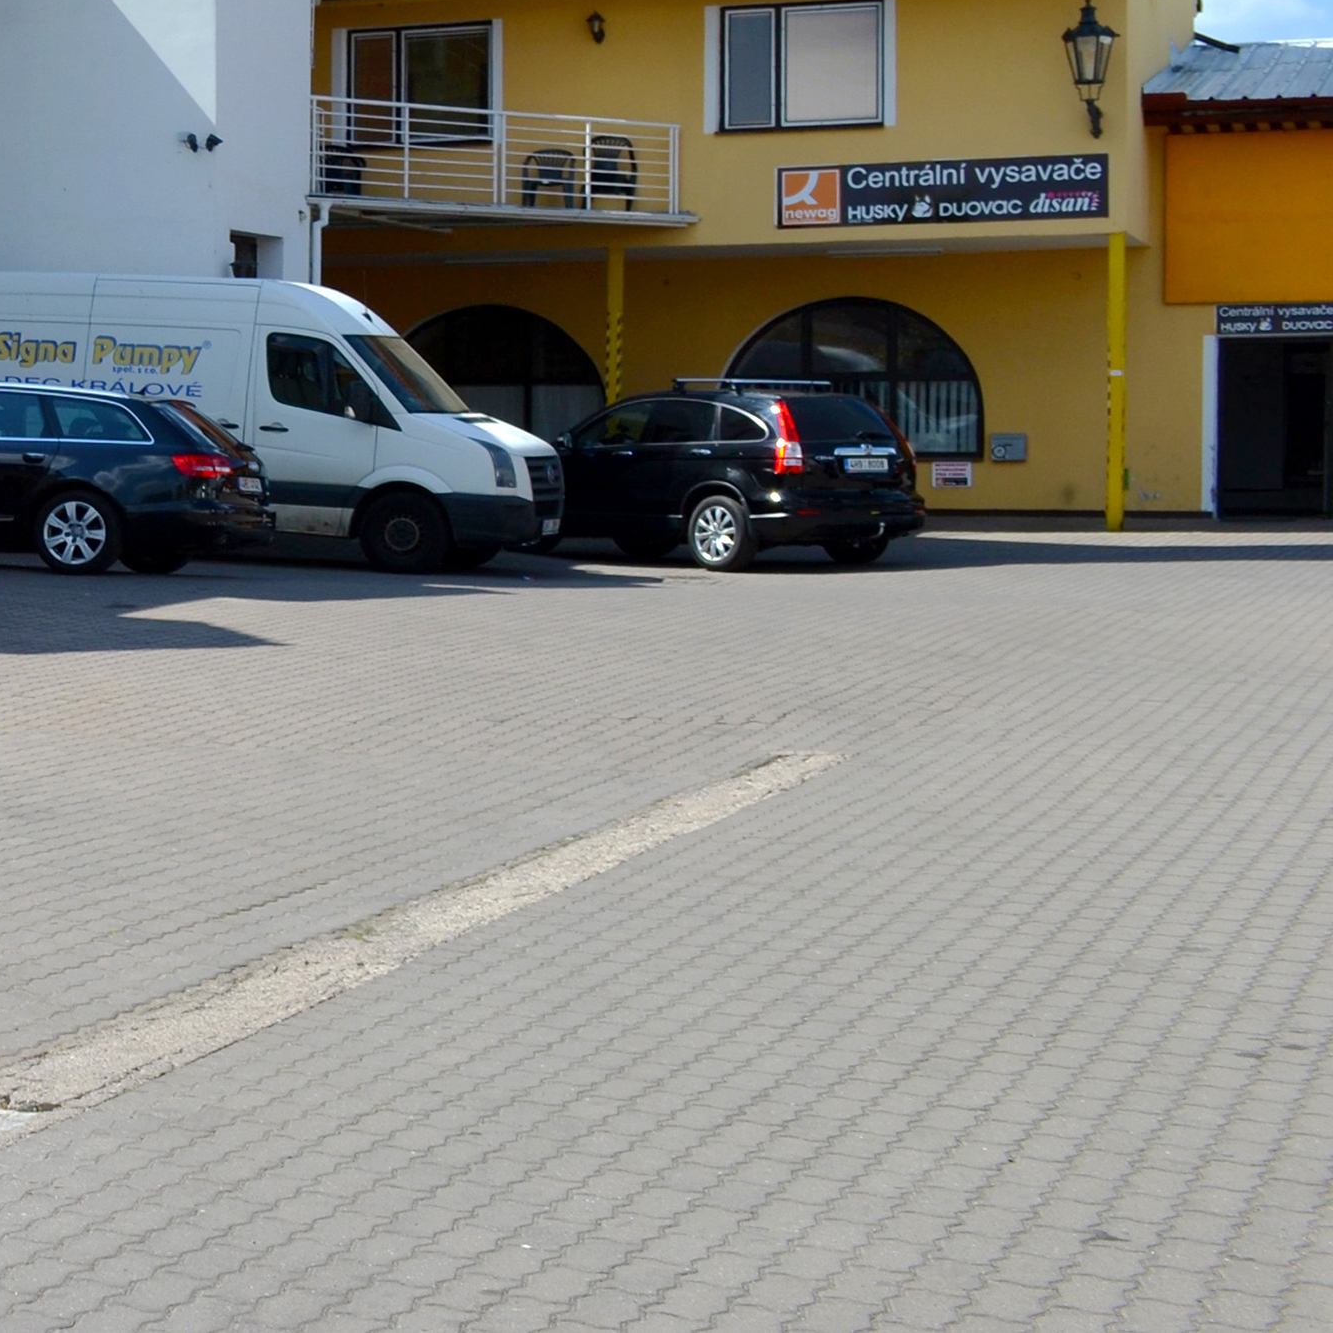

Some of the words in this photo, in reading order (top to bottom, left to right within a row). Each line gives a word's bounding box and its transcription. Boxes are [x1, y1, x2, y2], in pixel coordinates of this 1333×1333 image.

[846, 163, 967, 189] Centrální
[974, 157, 1103, 189] vysavače
[785, 207, 837, 221] newag
[847, 203, 908, 222] HUSKY
[1029, 191, 1092, 214] disan
[1219, 306, 1274, 318] Centrální
[1220, 321, 1257, 333] HUSKY
[92, 335, 202, 375] Pumpy
